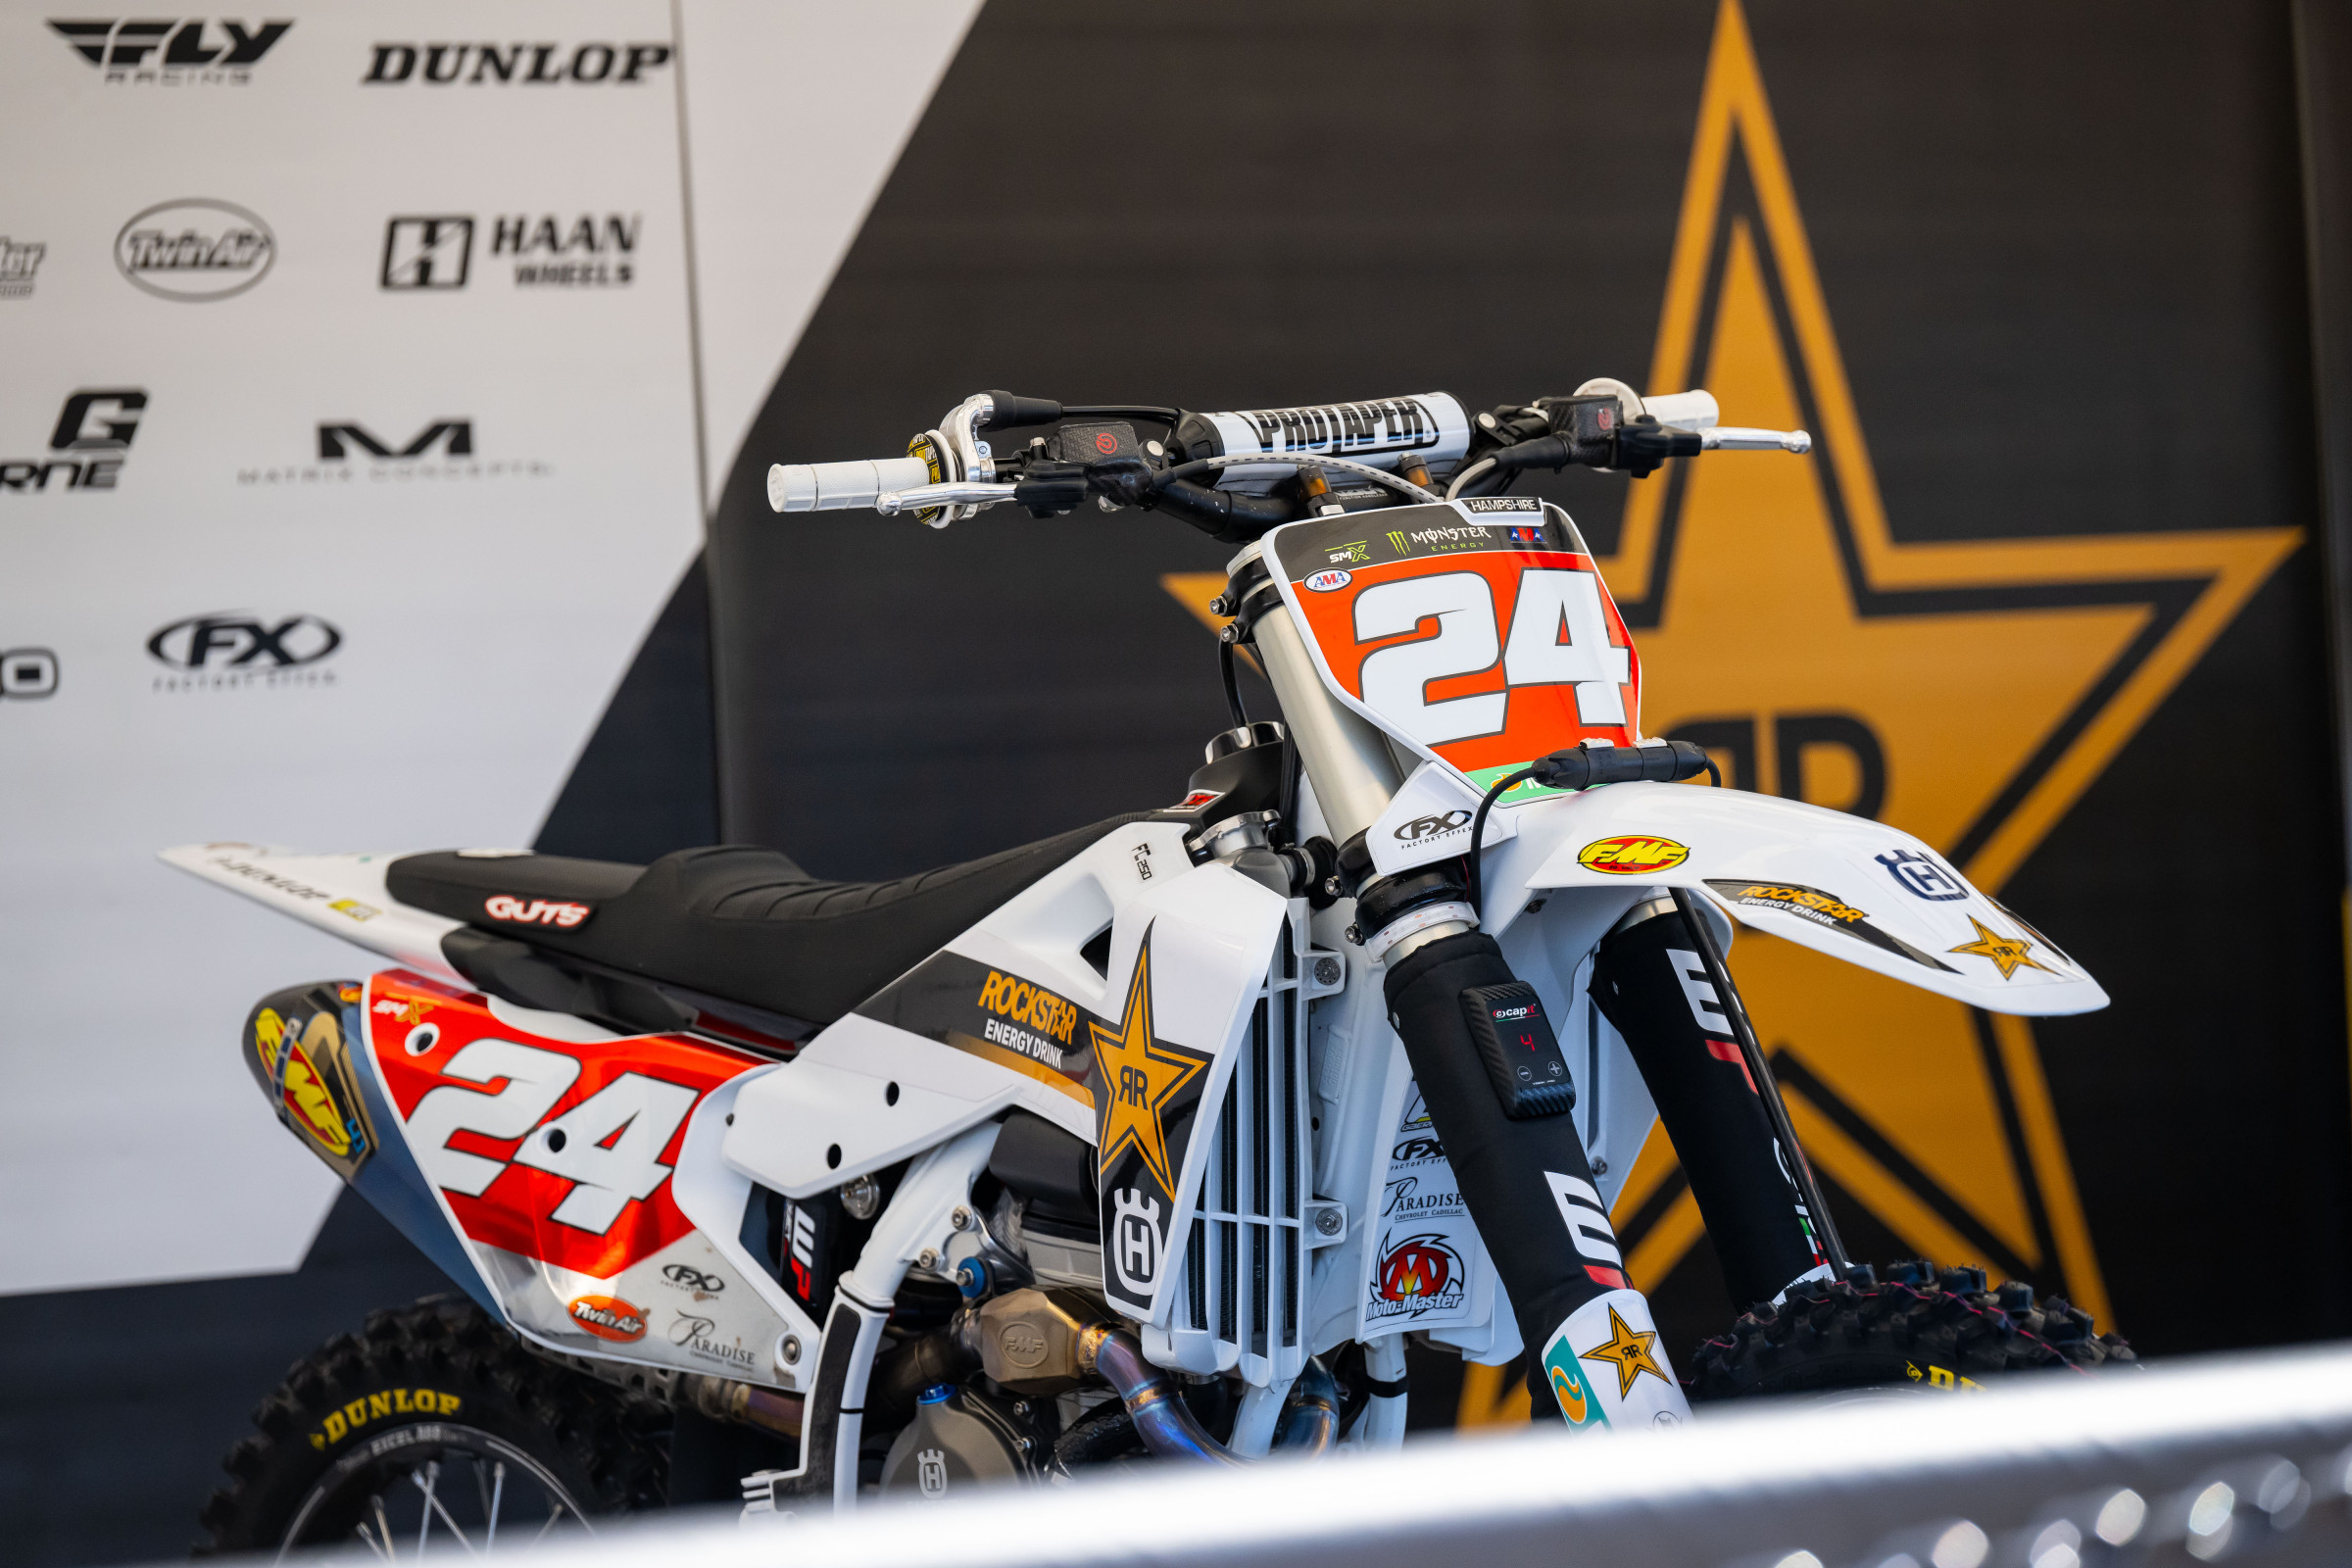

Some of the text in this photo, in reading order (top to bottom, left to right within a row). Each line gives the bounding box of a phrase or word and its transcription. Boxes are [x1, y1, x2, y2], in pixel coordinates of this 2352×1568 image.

[45, 19, 294, 66] FLY
[361, 43, 671, 84] DUNLOP
[491, 215, 643, 256] HAAN
[1470, 498, 1539, 513] HAMPSHIRE
[1431, 542, 1486, 552] ENERGY
[1509, 527, 1544, 543] AMA
[1329, 544, 1371, 564] SMX
[1314, 571, 1348, 588] AMA
[188, 616, 303, 668] FX
[1351, 565, 1632, 748] 24
[1408, 811, 1458, 840] FX
[1400, 834, 1444, 850] FACTORY
[1577, 840, 1691, 865] FMF
[486, 896, 590, 927] GUTS
[1737, 885, 1865, 923] ROCKSTAR
[1740, 897, 1838, 925] ENERGY DRINK
[977, 970, 1078, 1046] ROCKSTAR
[984, 1018, 1064, 1069] ENERGY DRINK
[1519, 1033, 1536, 1052] 4
[405, 1036, 703, 1238] 24
[1390, 1159, 1427, 1171] FACTORY
[1381, 1176, 1464, 1218] PARADISE
[1395, 1210, 1429, 1221] CHEVROLET
[322, 1388, 462, 1445] DUNLOP
